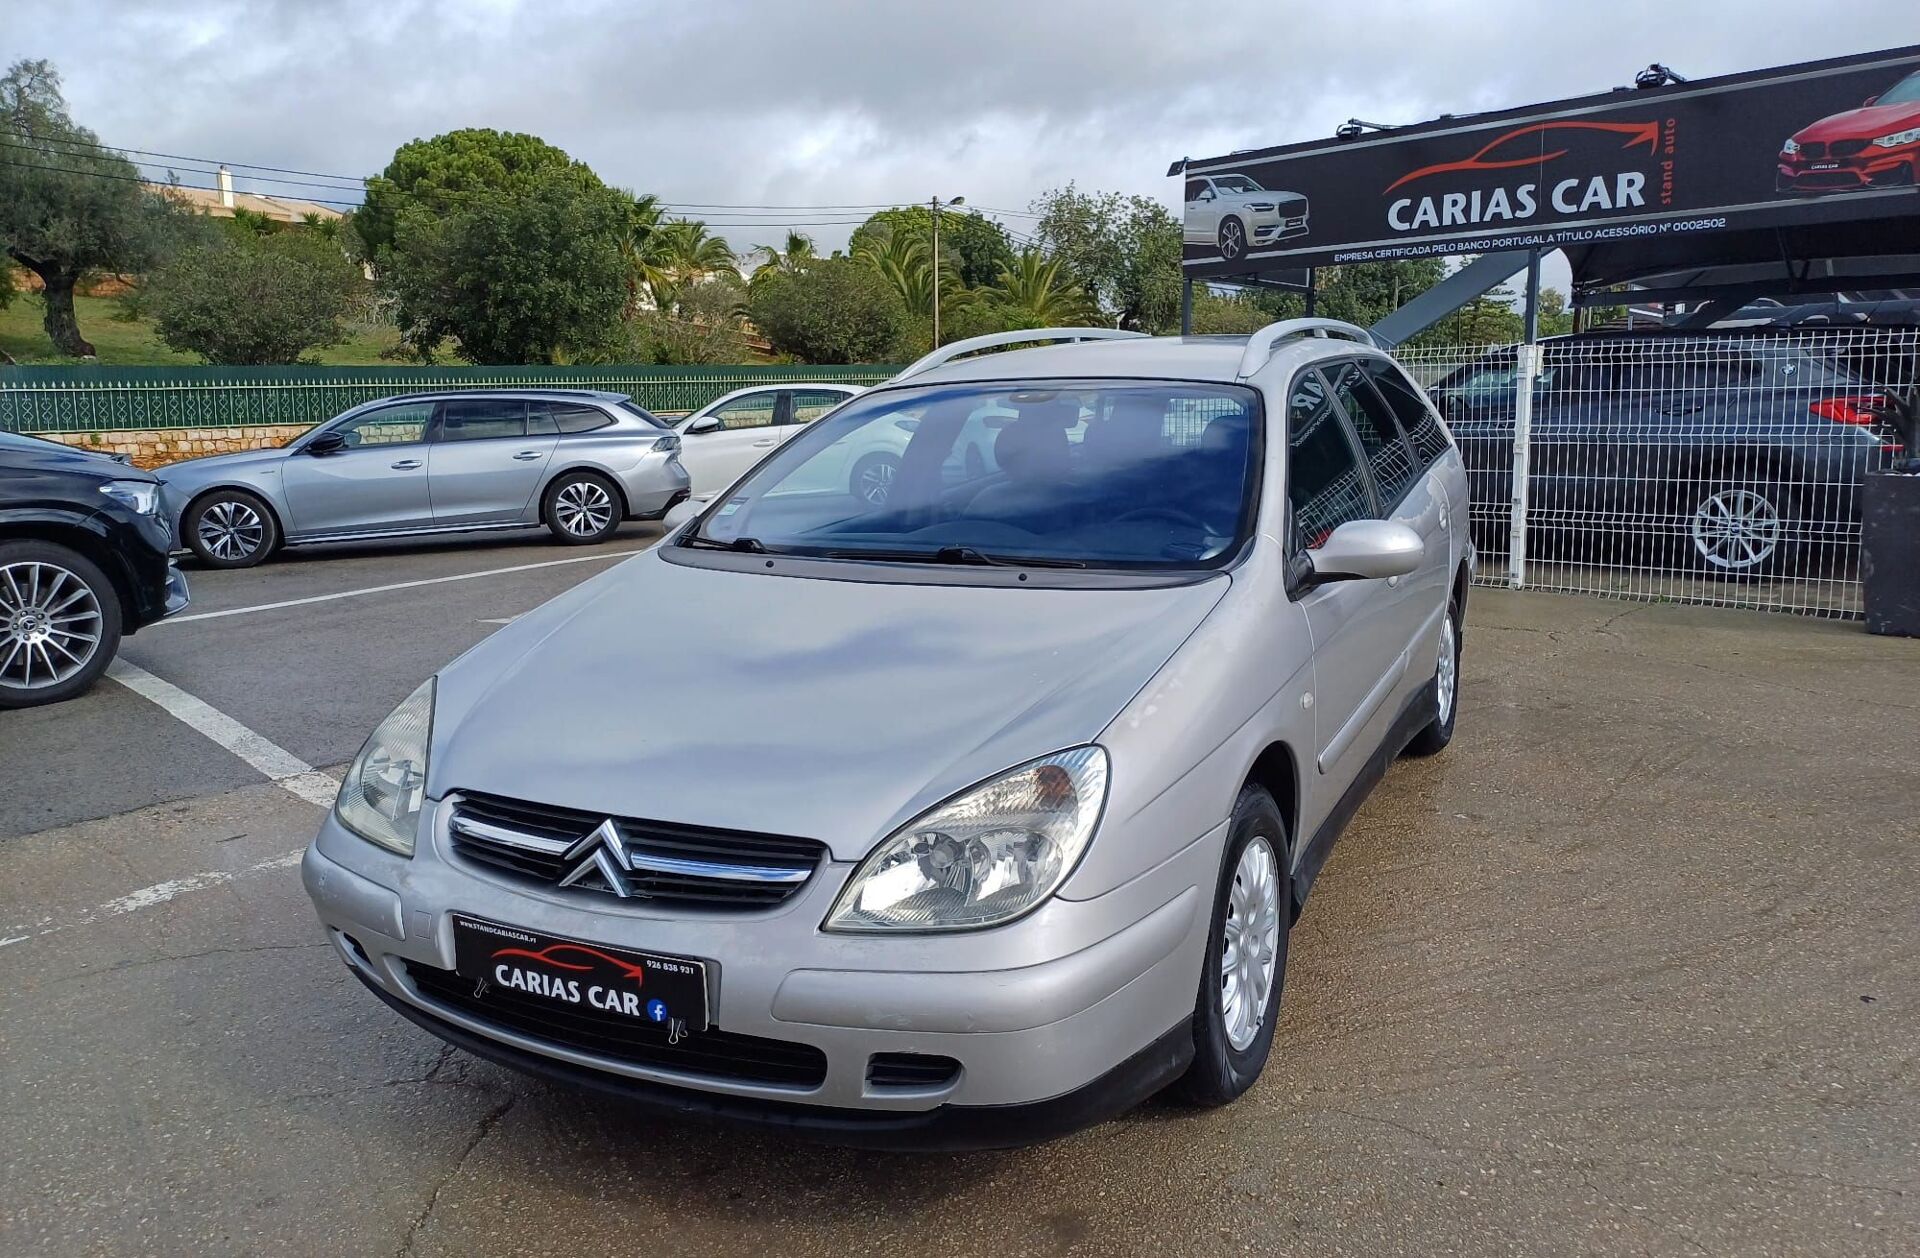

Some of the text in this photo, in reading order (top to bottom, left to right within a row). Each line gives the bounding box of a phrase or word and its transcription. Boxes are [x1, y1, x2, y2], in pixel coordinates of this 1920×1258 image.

[1660, 117, 1676, 205] stand auto
[1387, 171, 1645, 231] CARIAS CAR
[1334, 251, 1374, 262] EMPRESA
[1375, 245, 1431, 258] CERTIFICADA
[1432, 242, 1456, 253] PELO
[1457, 239, 1490, 251] BANCO
[1492, 232, 1546, 247] PORTUGAL
[1545, 233, 1555, 243] A
[1556, 229, 1593, 242] TÍTULO
[1594, 222, 1657, 239] ACESSÓRIO
[1672, 217, 1726, 232] 0002502
[495, 964, 640, 1017] CARIAS CAR
[646, 959, 694, 975] 926 838 931
